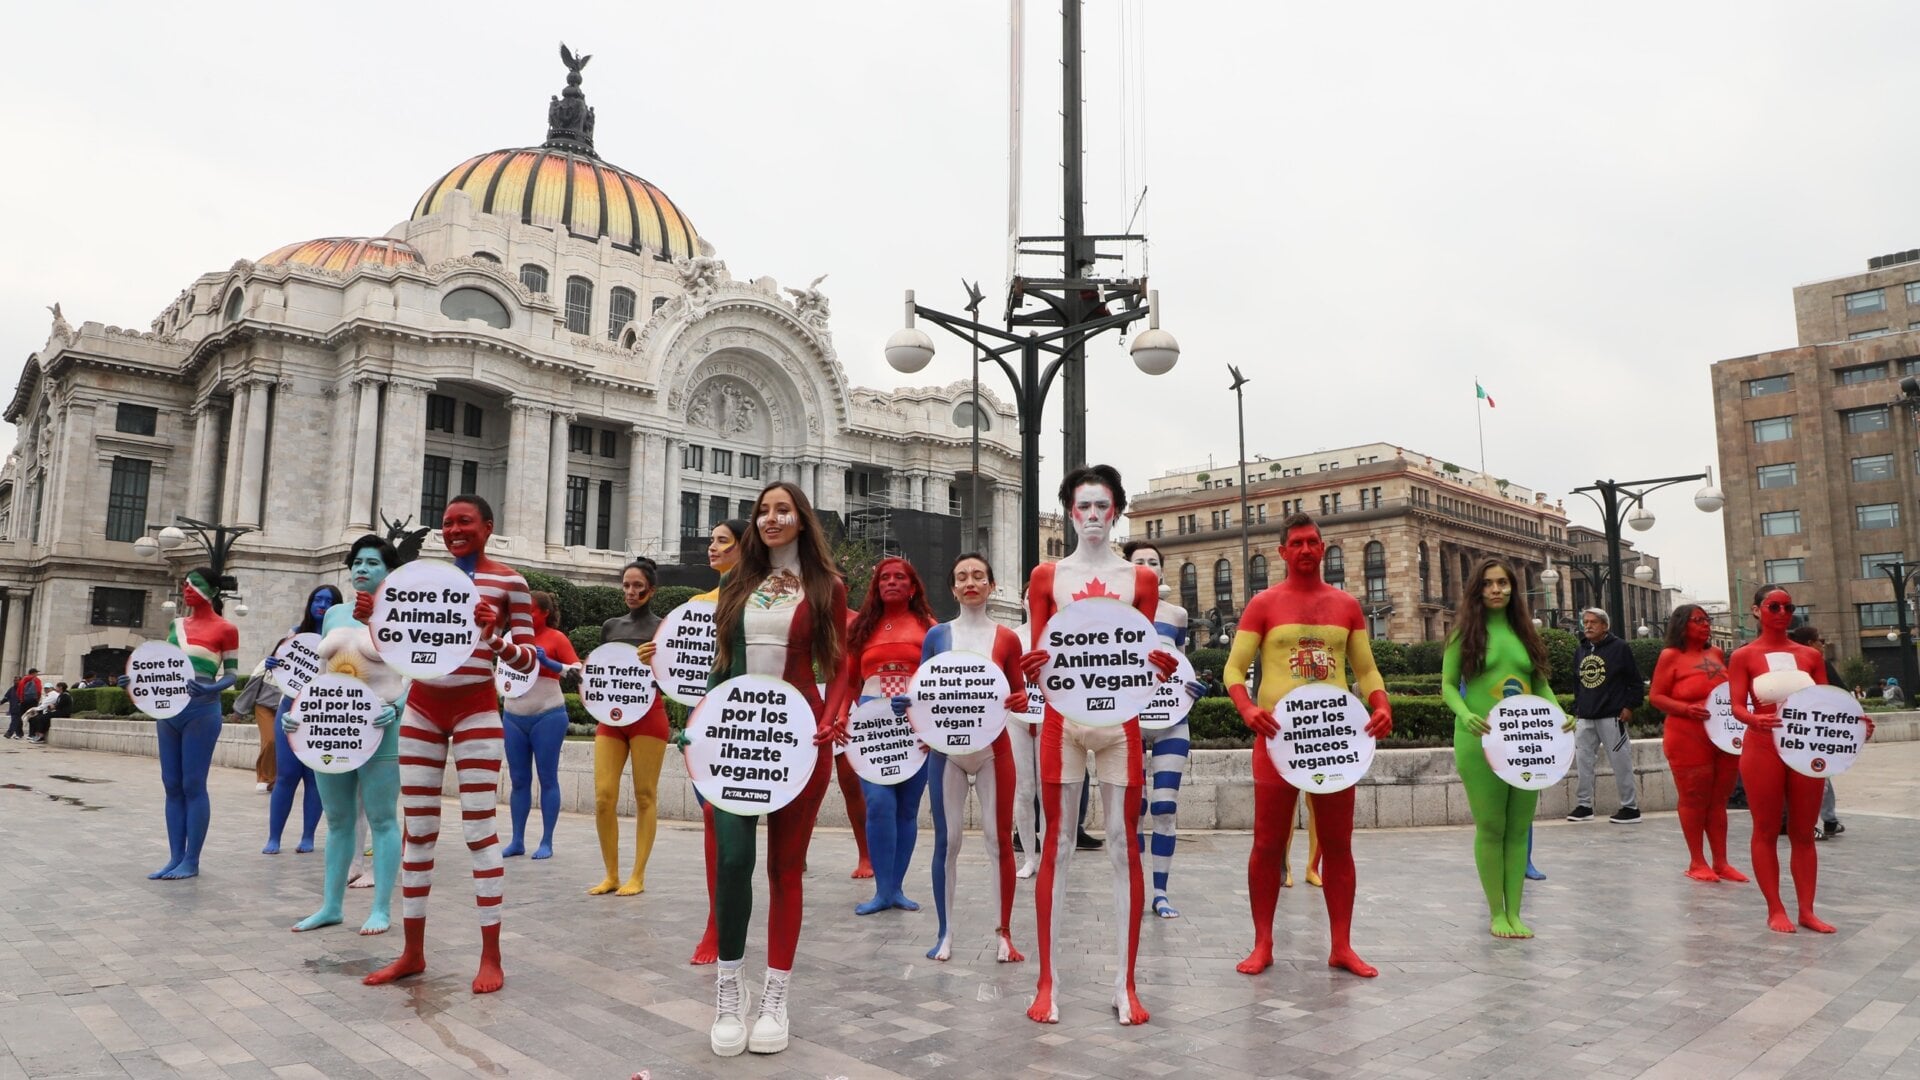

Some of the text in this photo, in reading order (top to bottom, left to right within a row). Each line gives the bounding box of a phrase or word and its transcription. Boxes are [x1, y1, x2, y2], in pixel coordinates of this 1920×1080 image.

[707, 364, 720, 375] DE
[385, 588, 469, 604] Score for
[386, 608, 467, 626] Animals,
[378, 628, 472, 646] Go Vegan!
[677, 625, 717, 637] por lo
[1050, 628, 1145, 646] Score for
[291, 640, 319, 661] Score
[666, 638, 715, 652] animal
[133, 658, 184, 670] Score for
[286, 652, 319, 673] Anima
[676, 652, 713, 666] ¡hazt
[1053, 650, 1144, 669] Animals,
[294, 667, 312, 683] Veg
[505, 671, 529, 682] vegan!
[586, 665, 650, 677] Ein Treffer
[930, 664, 985, 675] Marquez
[136, 671, 184, 683] Animals,
[920, 678, 995, 688] un but pour
[1047, 675, 1075, 690] Go
[1080, 671, 1153, 691] Vegan!
[133, 685, 188, 697] Go Vegan!
[309, 686, 363, 697] Hacé un
[590, 678, 645, 691] für Tiere,
[585, 691, 649, 704] leb vegan!
[727, 687, 786, 705] Anota
[918, 690, 998, 701] les animaux,
[300, 699, 371, 712] gol por los
[931, 704, 985, 714] devenez
[1285, 694, 1347, 712] ¡Marcad
[303, 713, 367, 726] animales,
[721, 708, 788, 724] por los
[1292, 711, 1345, 728] por los
[1499, 708, 1550, 718] Faça um
[1782, 708, 1860, 724] Ein Treffer
[853, 716, 909, 730] Zabijte go
[935, 718, 975, 730] végan
[1499, 718, 1554, 731] gol pelos
[310, 725, 360, 736] ¡hacete
[705, 724, 798, 747] animales,
[1283, 725, 1357, 741] animales,
[1504, 731, 1553, 742] animais,
[1787, 723, 1854, 741] für Tiere,
[307, 739, 362, 751] vegano!
[852, 735, 864, 743] za
[1780, 737, 1857, 754] leb vegan!
[720, 743, 781, 762] ¡hazte
[860, 739, 914, 755] postanite
[1294, 740, 1349, 754] haceos
[1518, 743, 1542, 755] seja
[869, 751, 908, 765] vegan!
[1288, 751, 1359, 770] veganos!
[1507, 755, 1555, 767] vegano!
[709, 764, 789, 782] vegano!
